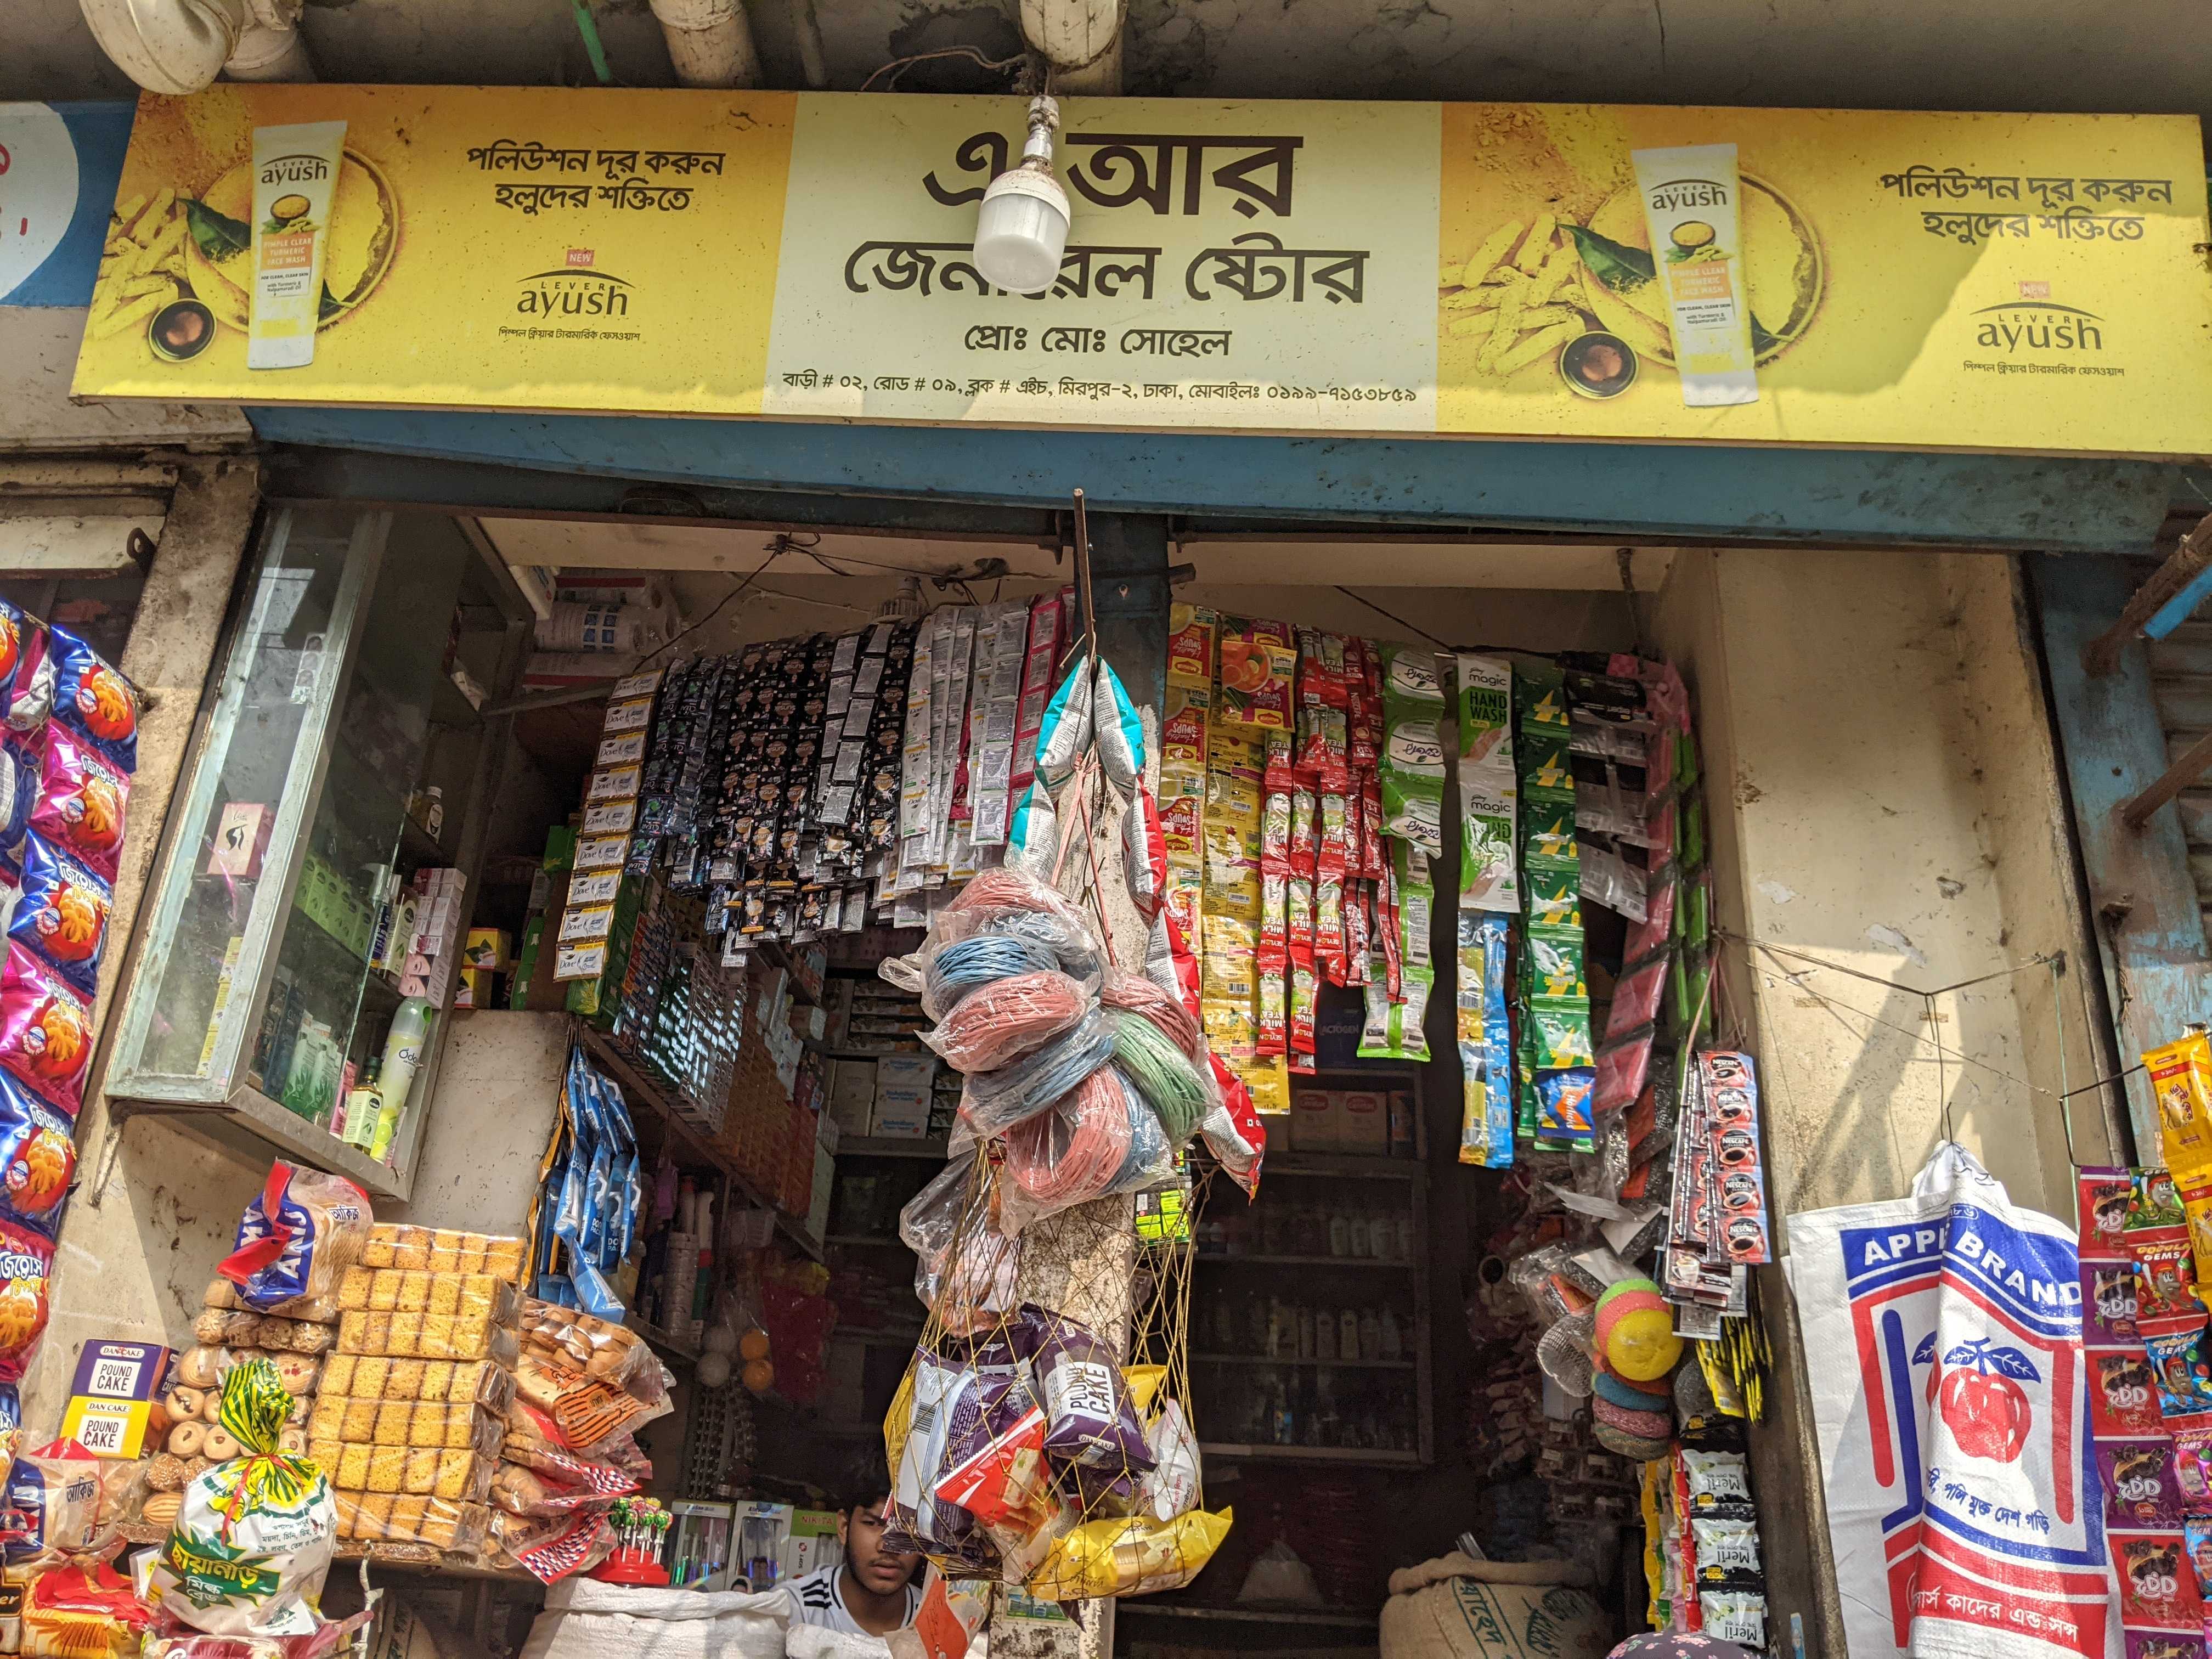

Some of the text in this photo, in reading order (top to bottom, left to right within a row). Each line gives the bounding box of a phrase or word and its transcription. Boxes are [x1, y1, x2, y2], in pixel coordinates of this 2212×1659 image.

[467, 139, 726, 180] পলিউশন দূর করুন
[261, 162, 328, 185] ayush
[1066, 133, 1304, 219] আর
[1880, 165, 2172, 209] পলিউশন দূর করুন
[495, 177, 694, 216] হলুদের শক্তিতে
[1652, 187, 1727, 212] ayush
[1921, 206, 2145, 245] হলুদের শক্তিতে
[291, 238, 312, 246] CLEAR
[569, 253, 592, 263] NEW
[1185, 232, 1370, 304] ষ্টোর
[540, 281, 606, 291] LEVER
[517, 285, 628, 319] ayush
[1999, 314, 2071, 324] LEVER
[964, 325, 1233, 358] প্রোঃ মোঃ সোহেল
[1977, 319, 2102, 353] ayush
[822, 375, 834, 388] #
[873, 376, 910, 391] রোড
[915, 377, 926, 391] #
[999, 379, 1011, 393] #
[1143, 383, 1182, 400] ঢাকা,
[1469, 673, 1506, 686] magic
[1470, 690, 1507, 709] HAND
[606, 715, 624, 724] Dove
[1470, 706, 1507, 724] WASH
[601, 748, 618, 757] Dove
[1471, 800, 1511, 814] magic
[585, 817, 605, 826] Dove
[1323, 833, 1344, 842] MILK
[579, 851, 598, 860] Dove
[628, 861, 648, 870] CLEAR
[572, 886, 590, 896] Dove
[1265, 916, 1282, 924] TEA
[1320, 916, 1339, 924] TEA
[565, 922, 583, 932] Dove
[1262, 924, 1284, 934] MILK
[1318, 924, 1339, 933] MILK
[1317, 937, 1340, 945] SEYLON
[558, 959, 577, 969] Dove
[1262, 1010, 1282, 1018] TEA
[1260, 1019, 1282, 1028] MILK
[1565, 1093, 1577, 1129] Horlicks
[329, 1204, 360, 1221] আকিজ
[2136, 1243, 2190, 1255] COCOLA
[2143, 1251, 2181, 1261] GEMS
[1955, 1230, 2083, 1306] BRAND
[121, 1348, 142, 1356] CAKE
[2158, 1344, 2187, 1355] GEMS
[100, 1364, 132, 1378] POUND
[97, 1375, 129, 1392] CAKE
[1088, 1367, 1107, 1416] CAKE
[88, 1402, 129, 1413] DAN CAKE
[86, 1420, 119, 1434] POUND
[83, 1431, 116, 1448] CAKE
[1096, 1438, 1115, 1450] CAKE
[2177, 1441, 2202, 1449] GEMS
[66, 1476, 95, 1503] আকিজ
[1707, 1479, 1740, 1491] Meril
[802, 1515, 834, 1525] NIKITA
[1995, 1507, 2021, 1527] দেশ
[1717, 1550, 1750, 1564] Meril
[185, 1576, 224, 1594] মিল্ক
[1945, 1593, 2002, 1620] কাদের
[2010, 1608, 2043, 1628] এন্ড
[1725, 1626, 1757, 1641] Meril
